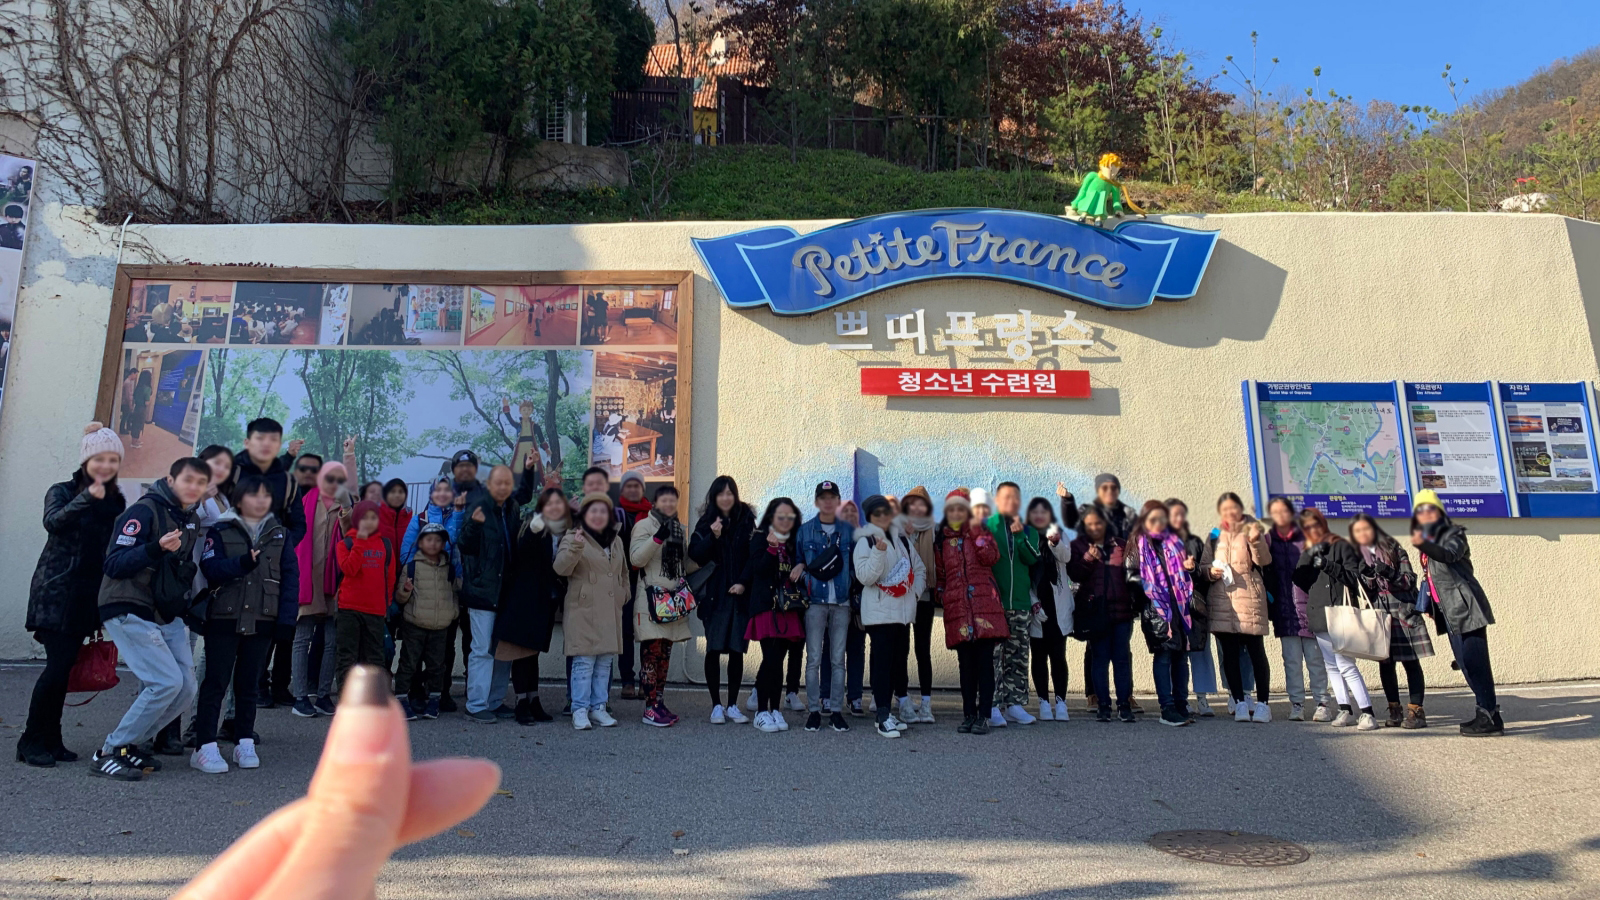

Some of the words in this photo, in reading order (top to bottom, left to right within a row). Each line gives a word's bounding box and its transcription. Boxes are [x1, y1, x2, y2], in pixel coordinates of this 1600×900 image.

[792, 227, 943, 296] Petite
[931, 220, 1127, 288] France
[898, 372, 973, 393] 청소년
[980, 373, 1057, 394] 수련원
